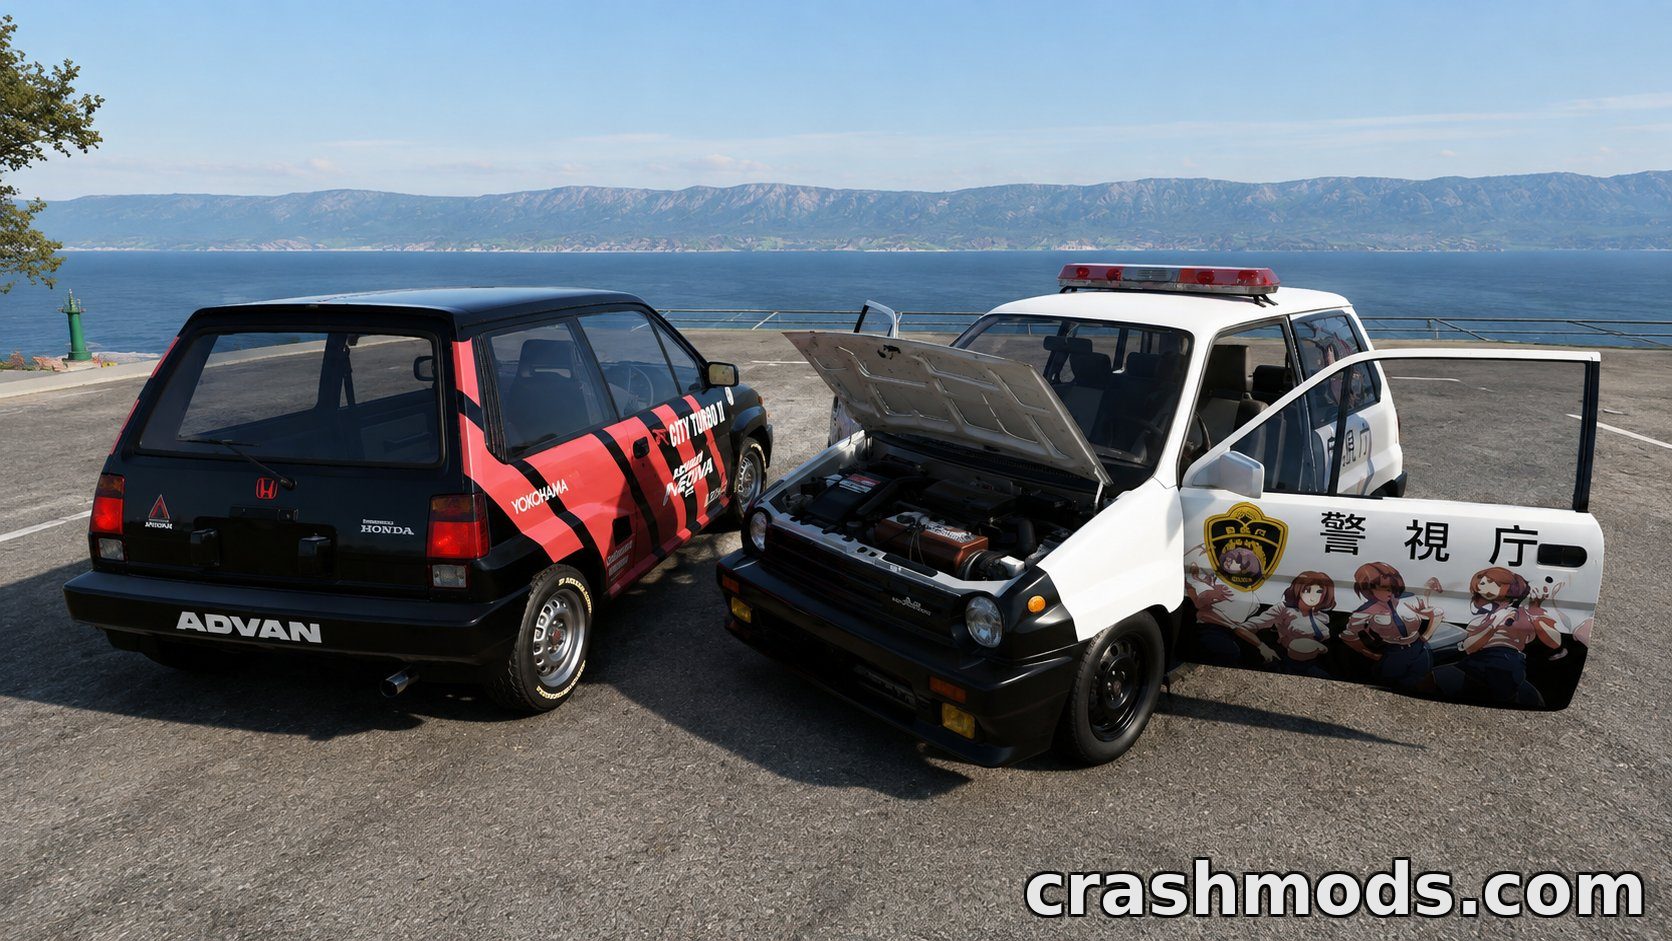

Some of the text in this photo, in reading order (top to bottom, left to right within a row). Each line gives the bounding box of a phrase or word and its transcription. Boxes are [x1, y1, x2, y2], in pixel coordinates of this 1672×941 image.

[669, 416, 690, 448] CITY
[690, 404, 718, 437] TURBO
[511, 478, 569, 514] YOKOHAMA
[361, 525, 414, 535] HONDA
[1320, 511, 1538, 567] 警視庁
[176, 611, 322, 643] ADVAN
